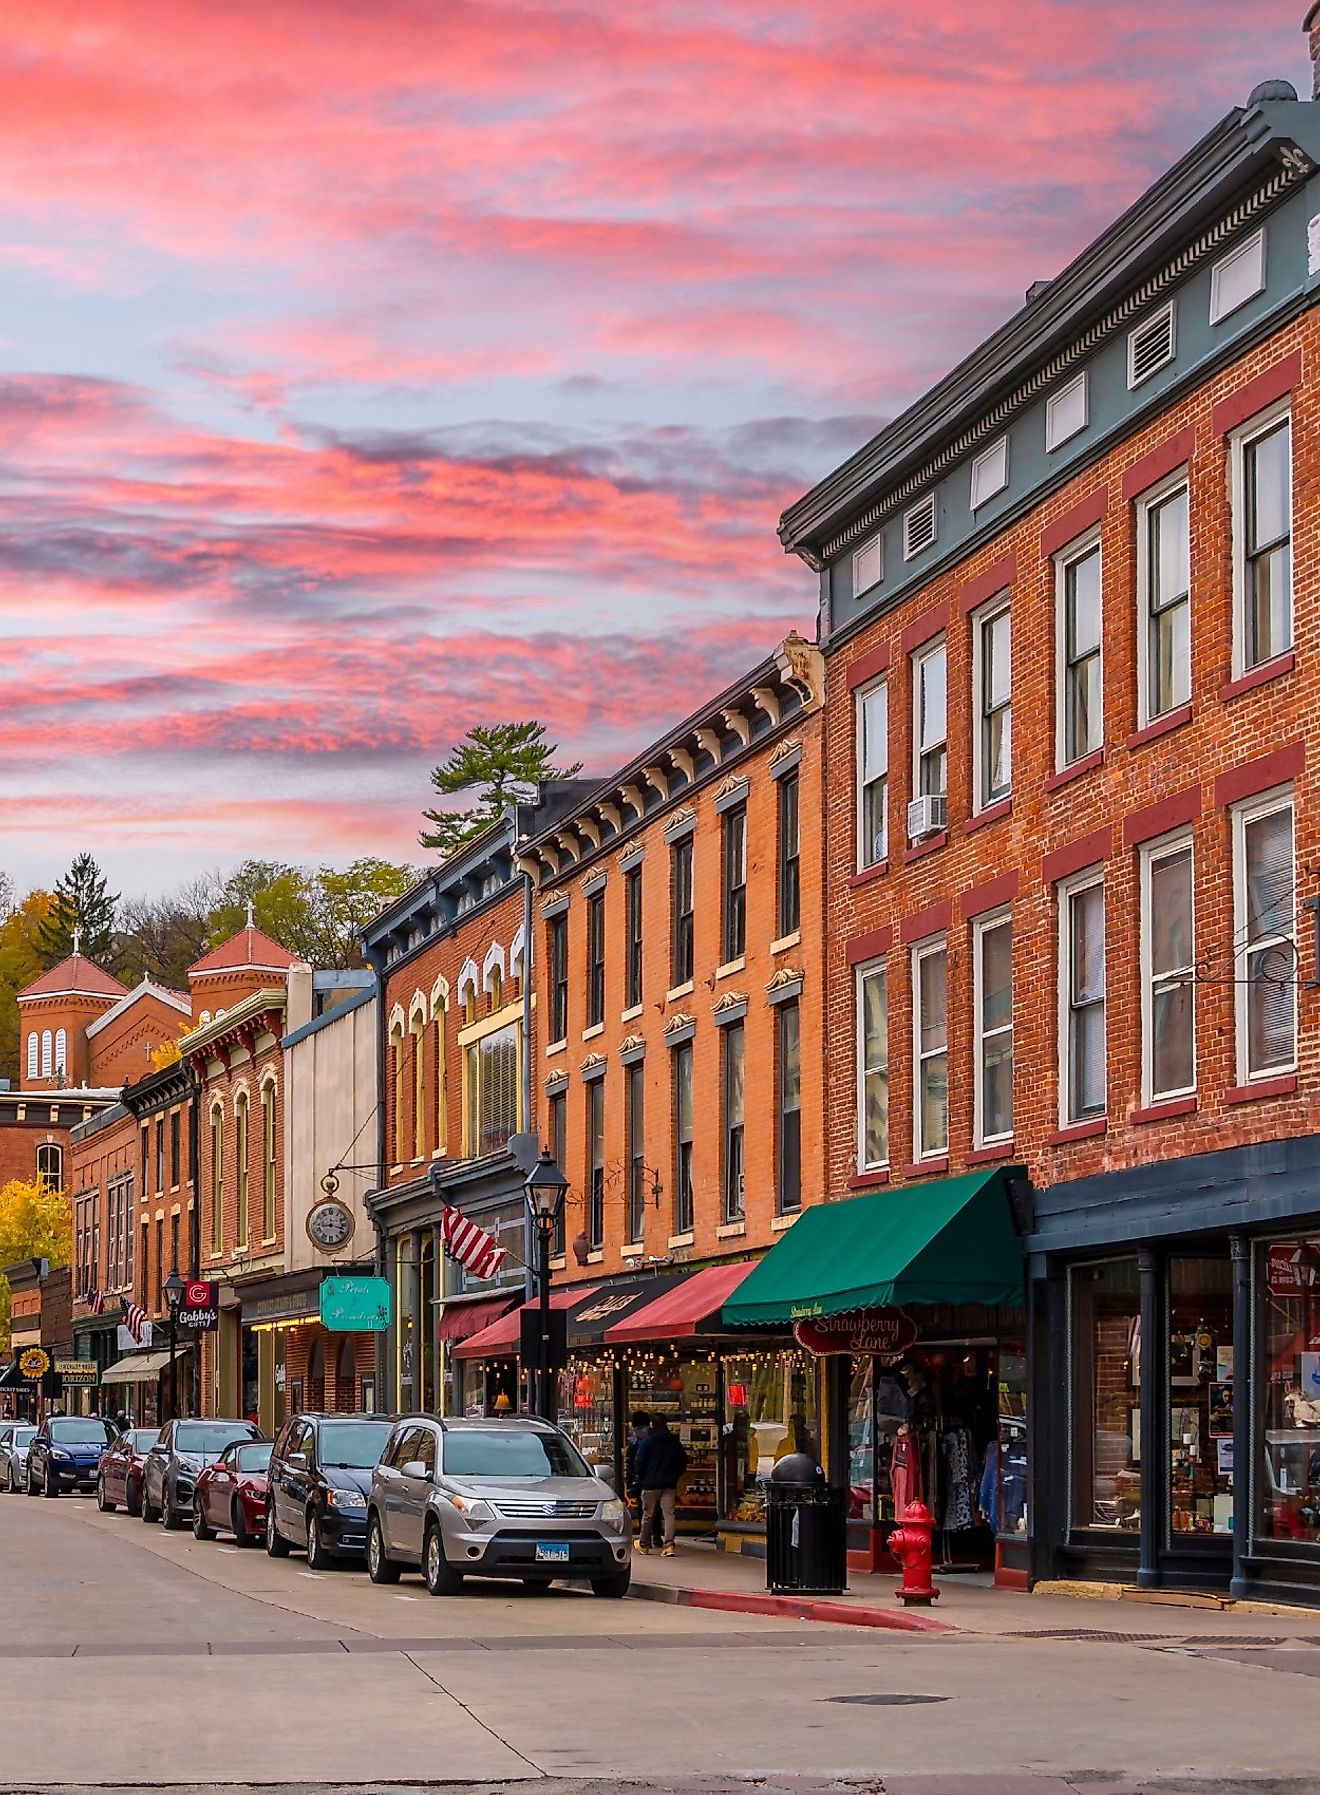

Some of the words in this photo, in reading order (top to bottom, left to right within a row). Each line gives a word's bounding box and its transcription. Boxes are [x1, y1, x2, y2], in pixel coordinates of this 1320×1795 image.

[180, 1308, 218, 1327] Gabby's
[814, 1311, 900, 1342] Strawberry
[849, 1331, 891, 1350] Lane
